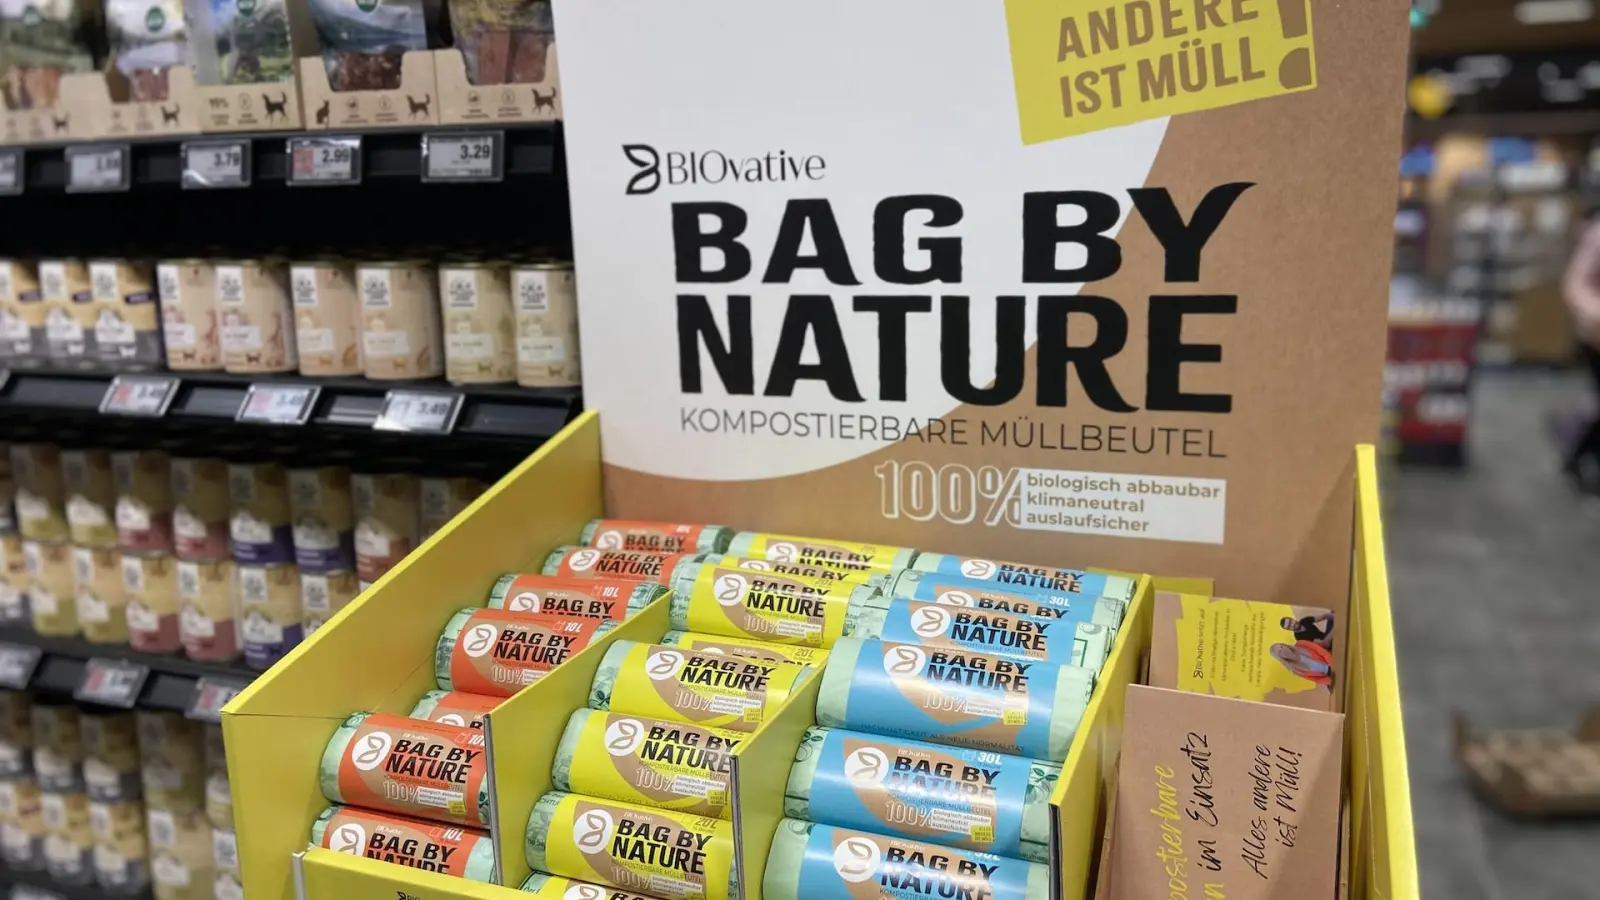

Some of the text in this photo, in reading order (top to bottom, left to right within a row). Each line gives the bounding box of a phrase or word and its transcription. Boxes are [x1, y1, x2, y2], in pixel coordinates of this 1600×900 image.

[1057, 0, 1259, 63] ANDERE
[1060, 37, 1265, 118] IST MÜLL
[322, 149, 350, 164] 2.99
[460, 144, 490, 160] 3.29
[667, 149, 826, 185] BIOvative
[671, 182, 1258, 286] BAG BY
[676, 295, 1238, 413] NATURE
[680, 407, 1227, 458] KOMPOSTIERBARE MÜLLBEUTEL
[874, 459, 1022, 528] 100%
[1027, 473, 1221, 499] biologisch abbaubar
[1027, 492, 1145, 513] klimaneutral
[1027, 511, 1150, 532] auslaufsicher
[625, 534, 660, 547] BAG
[801, 547, 842, 560] BAG
[595, 560, 664, 576] NATURE
[1000, 564, 1084, 581] BAG BY
[602, 586, 619, 597] 10L
[751, 580, 795, 595] BAG
[996, 571, 1083, 593] NATURE
[543, 598, 584, 612] BAG
[589, 601, 616, 615] BY
[746, 592, 827, 617] NATURE
[979, 597, 1069, 619] BAG BY
[1049, 596, 1070, 607] 30L
[564, 622, 583, 632] 10L
[955, 613, 1051, 634] BAG BY
[500, 629, 577, 648] BAG BY
[951, 625, 1048, 651] NATURE
[494, 642, 571, 665] NATURE
[688, 656, 738, 671] BAG
[742, 664, 776, 675] BY
[930, 652, 1032, 675] BAG BY
[680, 667, 770, 692] NATURE
[927, 664, 1029, 693] NATURE
[394, 740, 481, 763] BAG BY
[648, 726, 701, 747] BAG
[705, 736, 741, 753] BY
[385, 753, 472, 783] NATURE
[641, 740, 731, 773] NATURE
[977, 752, 1002, 765] 30L
[894, 756, 1001, 785] BAG BY
[1273, 747, 1303, 848] ist Müll!
[694, 817, 720, 829] 20L
[885, 800, 932, 827] 100%
[1241, 744, 1273, 880] Alles andere
[369, 833, 457, 862] BAG BY
[617, 819, 713, 851] BAG BY
[612, 836, 707, 875] NATURE
[886, 847, 1000, 881] BAG BY
[1197, 840, 1222, 872] im
